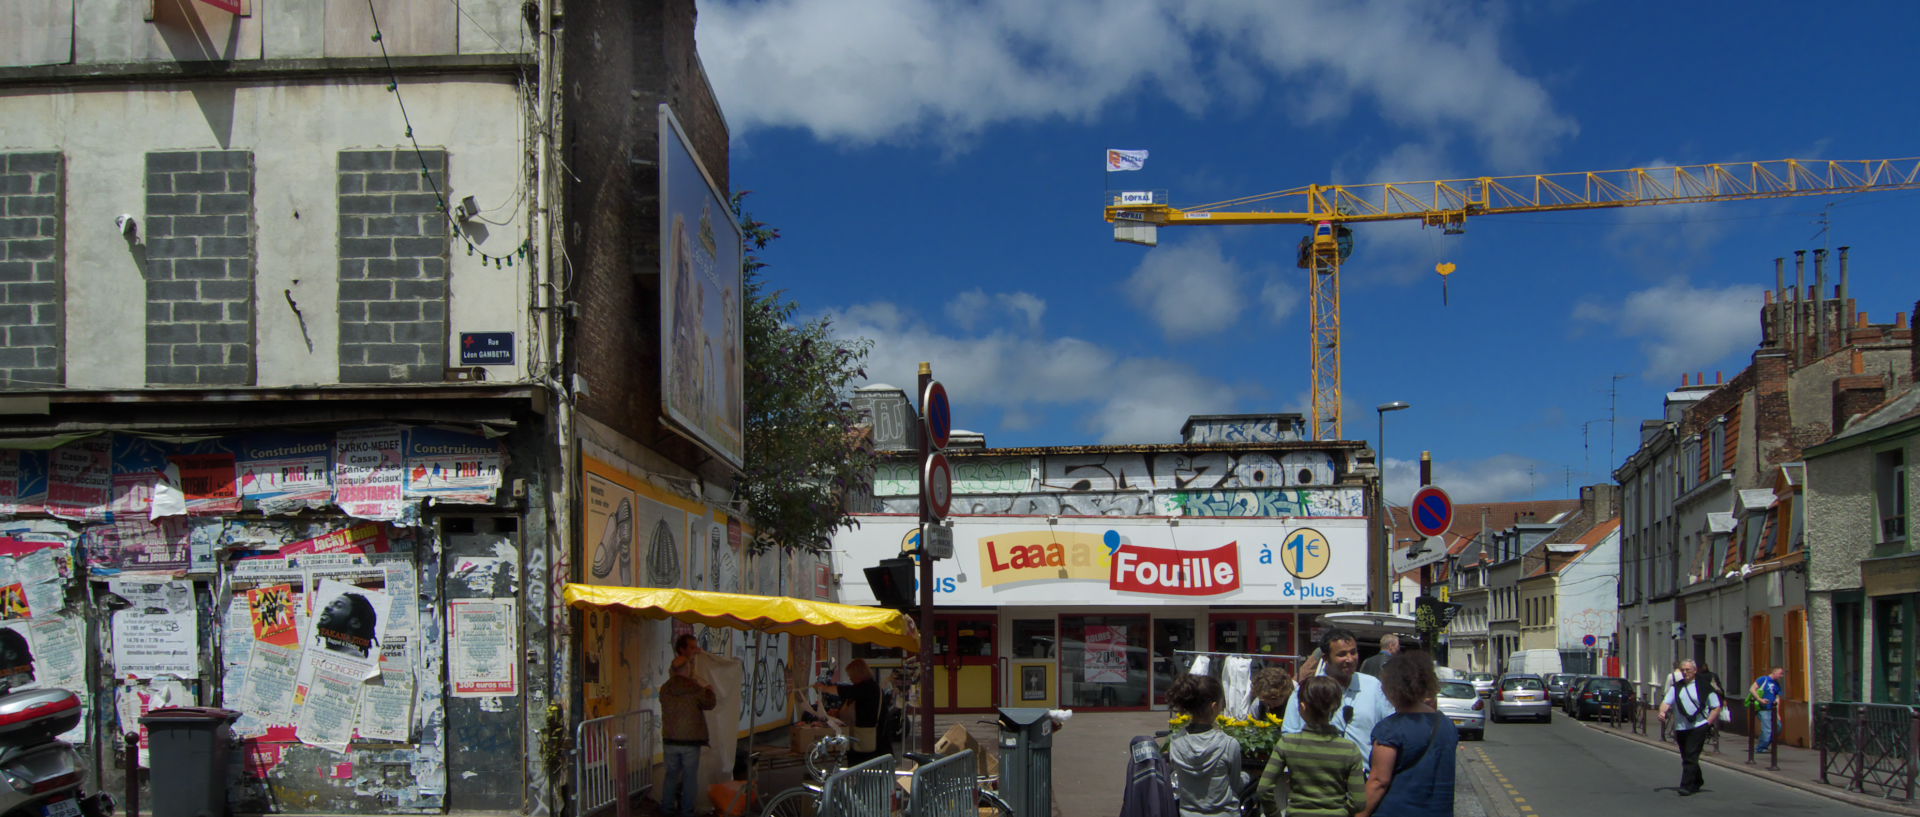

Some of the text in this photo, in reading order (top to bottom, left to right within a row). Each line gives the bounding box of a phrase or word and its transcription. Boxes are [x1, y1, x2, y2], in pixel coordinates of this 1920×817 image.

[487, 338, 499, 346] Rue
[463, 350, 510, 359] Léon GAMBETTA
[250, 443, 328, 459] Construisons
[338, 439, 400, 453] SARKO-MEDEF
[414, 442, 493, 454] Construisons
[350, 453, 389, 464] Casse la
[337, 464, 371, 475] France
[385, 463, 401, 471] ses
[337, 475, 366, 487] acquis
[313, 533, 345, 552] Jacky
[1259, 544, 1272, 564] à
[1116, 552, 1235, 588] Fouille
[1283, 582, 1335, 600] & plus
[1095, 650, 1120, 664] 20%
[324, 661, 365, 678] CONCERT
[476, 681, 497, 689] euros
